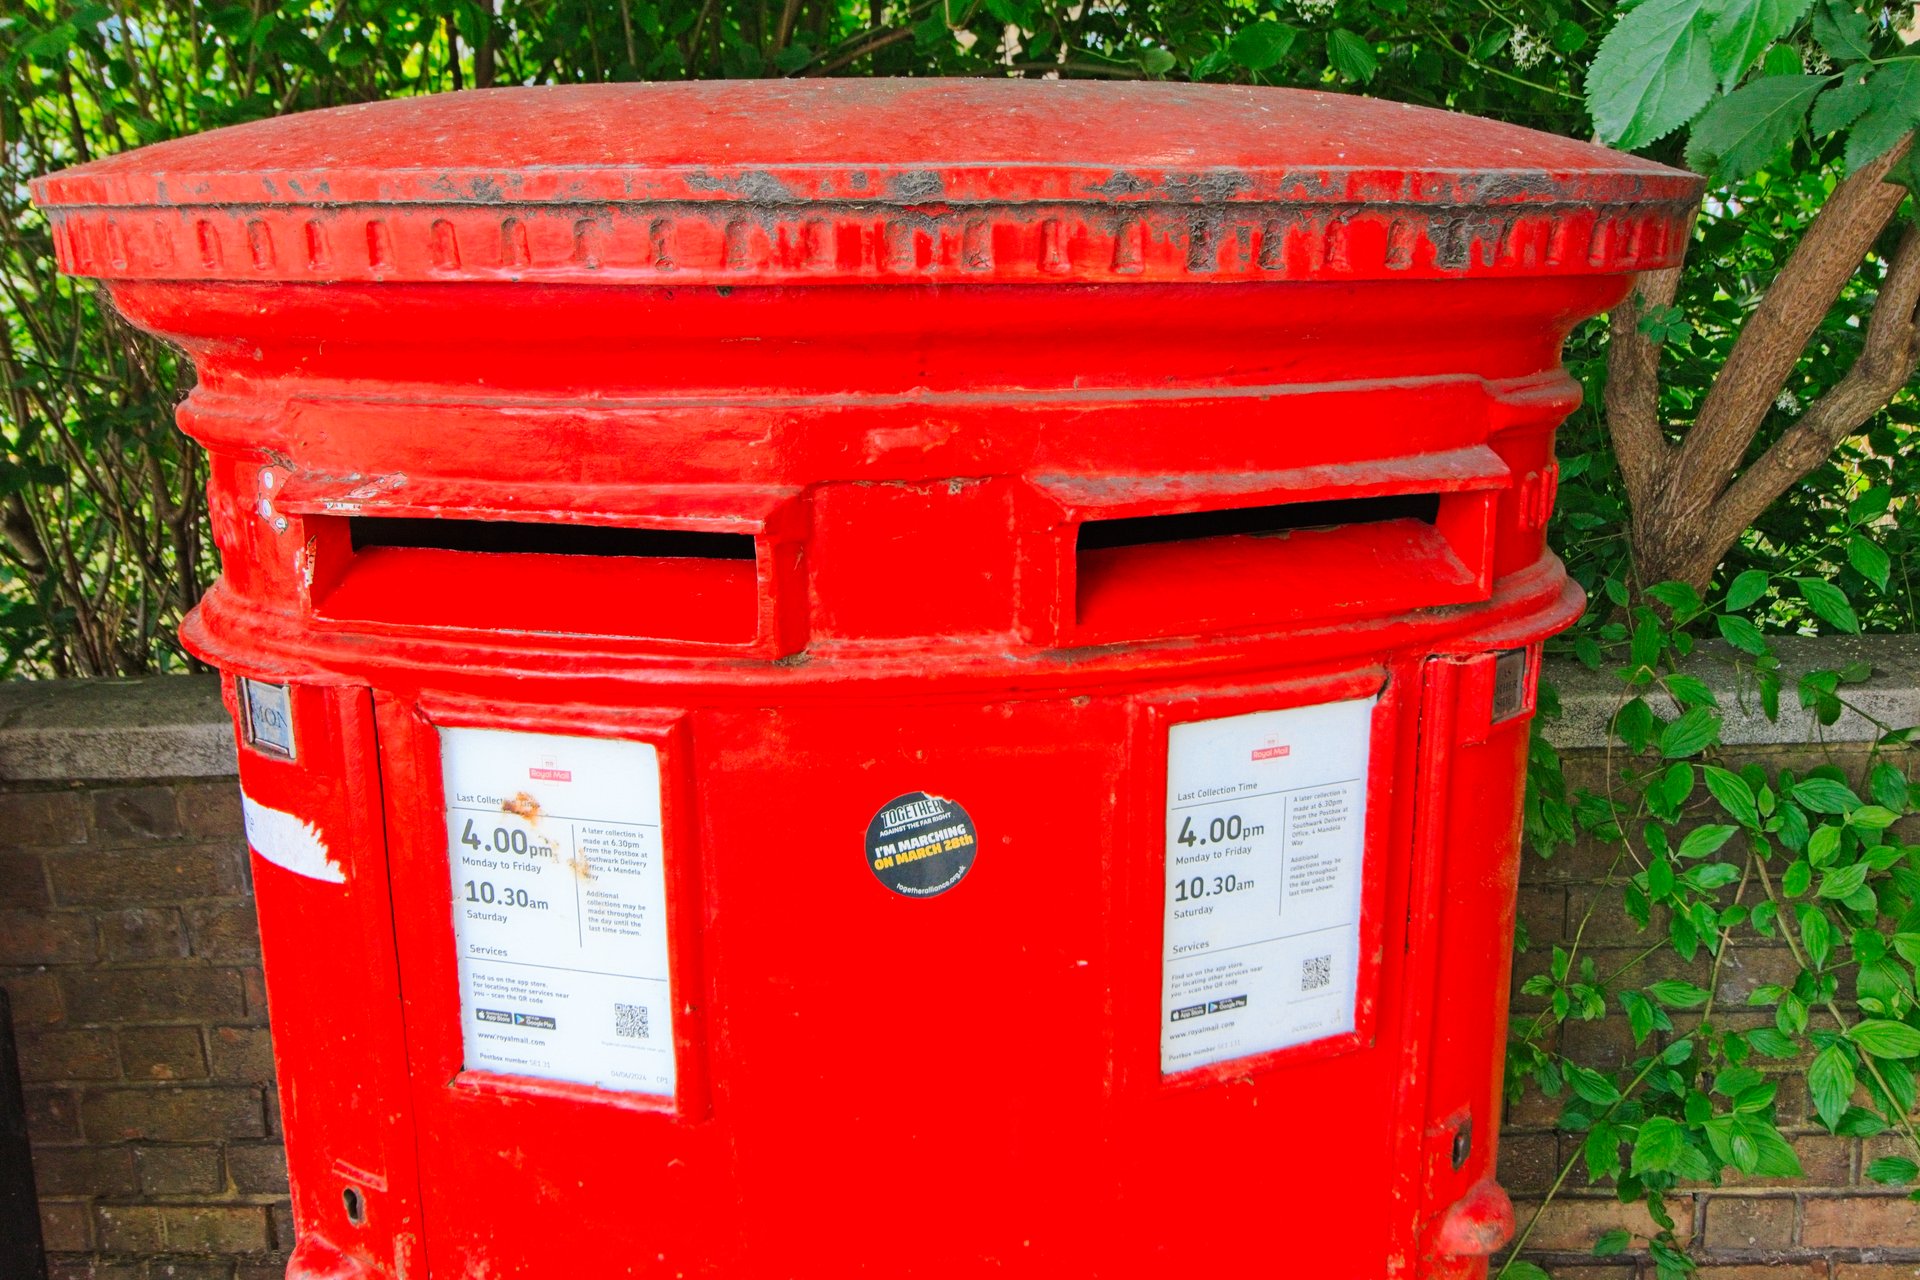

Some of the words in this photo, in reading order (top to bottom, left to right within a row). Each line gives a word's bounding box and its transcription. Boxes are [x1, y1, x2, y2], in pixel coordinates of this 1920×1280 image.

[1253, 749, 1272, 759] Royal
[1273, 746, 1288, 756] Mail
[531, 769, 552, 779] Royal
[553, 770, 570, 780] Mail
[457, 793, 474, 803] Last
[1178, 793, 1195, 801] Last
[1198, 786, 1236, 798] Collection
[1238, 783, 1258, 792] Time
[1314, 790, 1340, 800] collection
[1318, 799, 1343, 808] 6.30pm
[881, 799, 944, 828] TOGETHER
[1319, 808, 1340, 816] Postbox
[880, 825, 907, 837] AGAINST
[907, 822, 919, 831] THE
[932, 812, 951, 823] RIGHT
[1293, 820, 1322, 830] Southwark
[1324, 816, 1346, 824] Delivery
[1317, 824, 1340, 833] Mandela
[605, 829, 636, 838] collection
[1177, 814, 1264, 847] 4.00pm
[461, 818, 553, 859] 4.00pm
[611, 839, 639, 849] 6.30pm
[875, 843, 896, 858] I'M
[897, 823, 966, 852] MARCHING
[583, 846, 599, 854] from
[614, 849, 639, 858] Postbox
[874, 856, 894, 871] ON
[895, 842, 942, 865] MARCH
[943, 834, 974, 851] 28th
[1176, 851, 1210, 866] Monday
[1213, 850, 1222, 859] to
[1225, 846, 1252, 857] Friday
[1291, 853, 1319, 863] Additional
[462, 857, 497, 870] Monday
[501, 861, 509, 870] to
[513, 862, 541, 874] Friday
[584, 855, 618, 864] Southwark
[620, 858, 647, 869] Delivery
[1290, 863, 1319, 872] collections
[1307, 867, 1338, 877] throughout
[897, 865, 966, 894] togetheralliance.org.uk
[586, 890, 618, 899] Additional
[1175, 874, 1255, 902] 10.30am
[465, 880, 549, 910] 10.30am
[587, 900, 620, 908] collections
[467, 910, 507, 924] Saturday
[607, 910, 643, 919] throughout
[1174, 905, 1214, 919] Saturday
[470, 944, 507, 957] Services
[1172, 941, 1209, 954] Services
[1183, 978, 1206, 987] locating
[1225, 970, 1248, 979] services
[485, 983, 509, 993] locating
[510, 985, 526, 993] other
[529, 988, 553, 997] services
[478, 1032, 545, 1046] www.royalmail.com
[480, 1053, 502, 1061] Postbox
[1193, 1047, 1215, 1055] number
